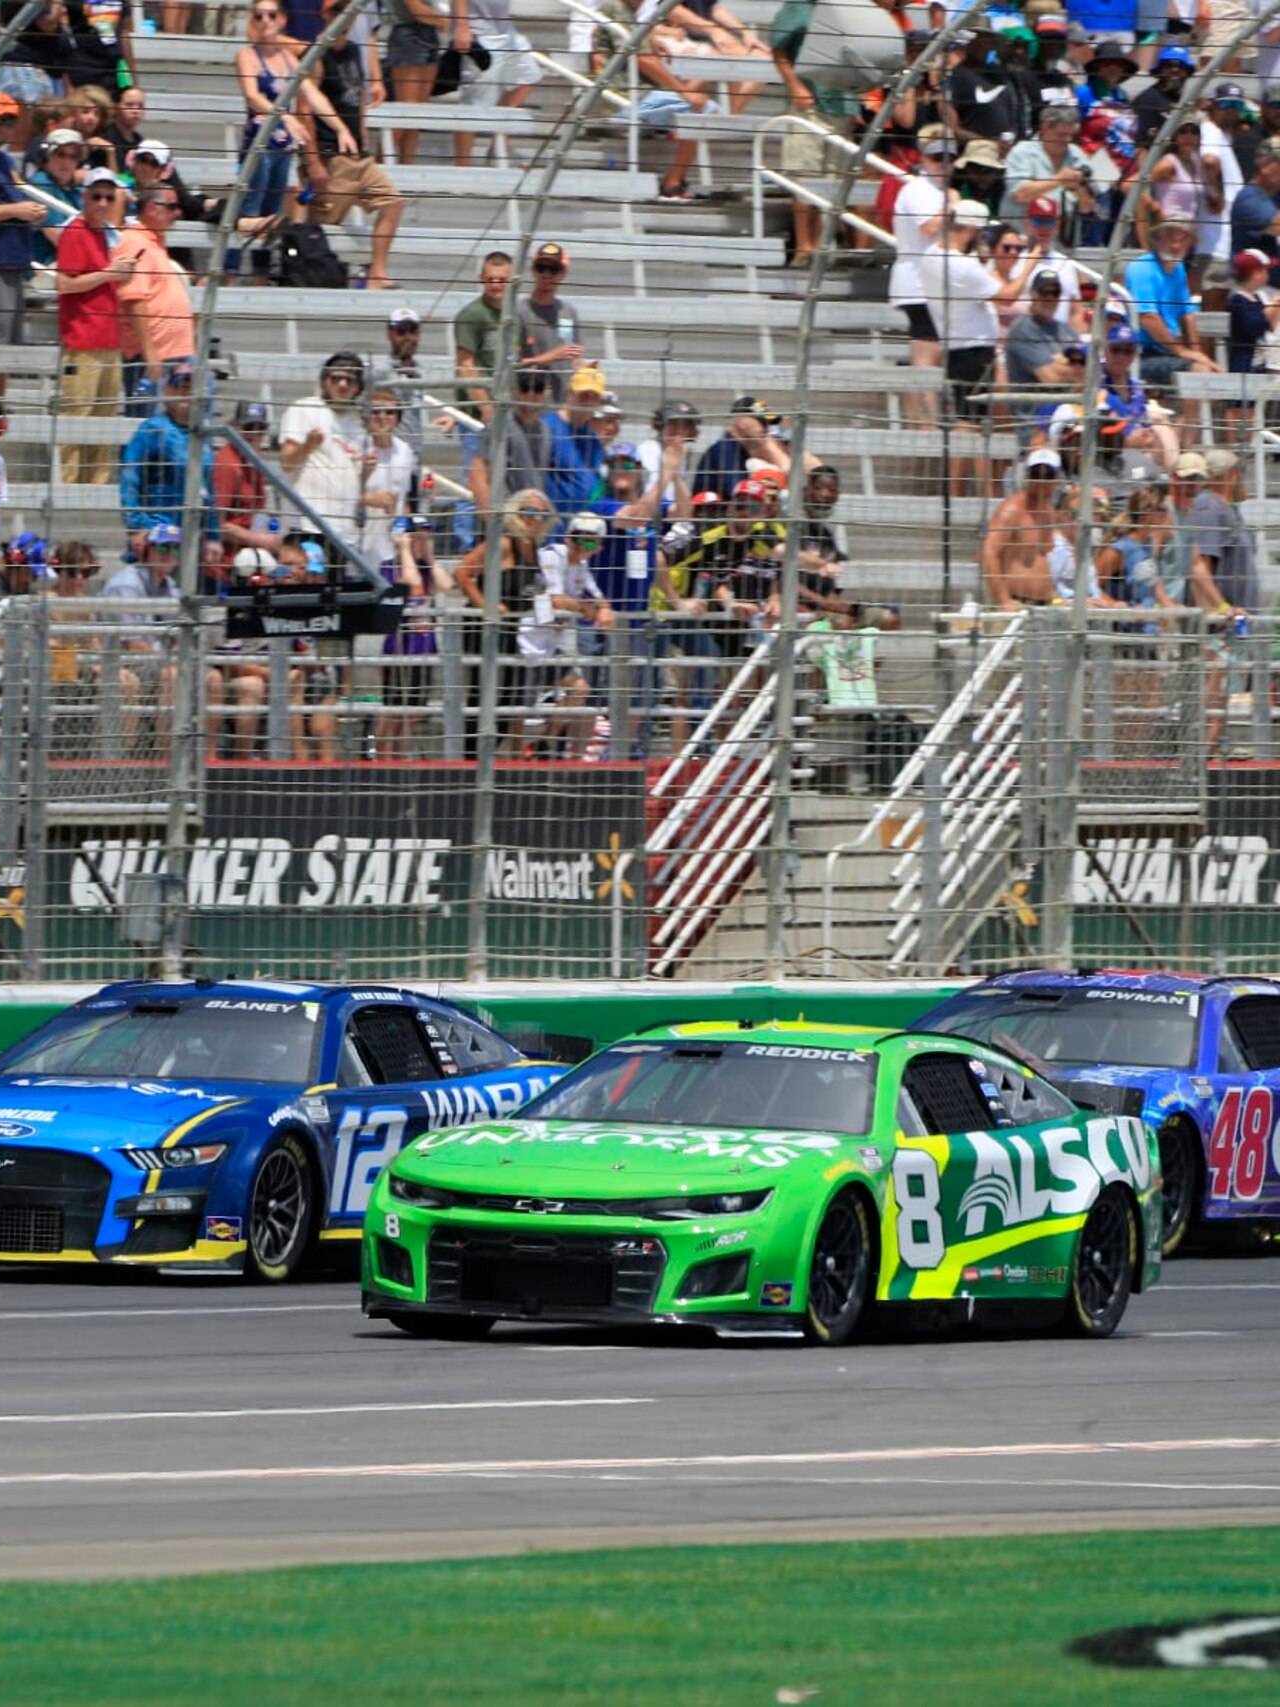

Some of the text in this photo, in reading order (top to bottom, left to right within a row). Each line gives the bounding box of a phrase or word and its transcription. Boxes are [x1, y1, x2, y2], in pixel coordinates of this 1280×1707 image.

[70, 834, 452, 911] QUKER STATE
[484, 848, 595, 900] Walmart
[204, 999, 298, 1014] BLANEY
[1086, 990, 1186, 1005] BOWMAN
[745, 1045, 867, 1063] REDDICK
[329, 1107, 408, 1214] 12
[1209, 1086, 1273, 1200] 48
[956, 1115, 1151, 1236] ALSCO
[385, 1213, 401, 1238] 8
[891, 1148, 947, 1270] 8
